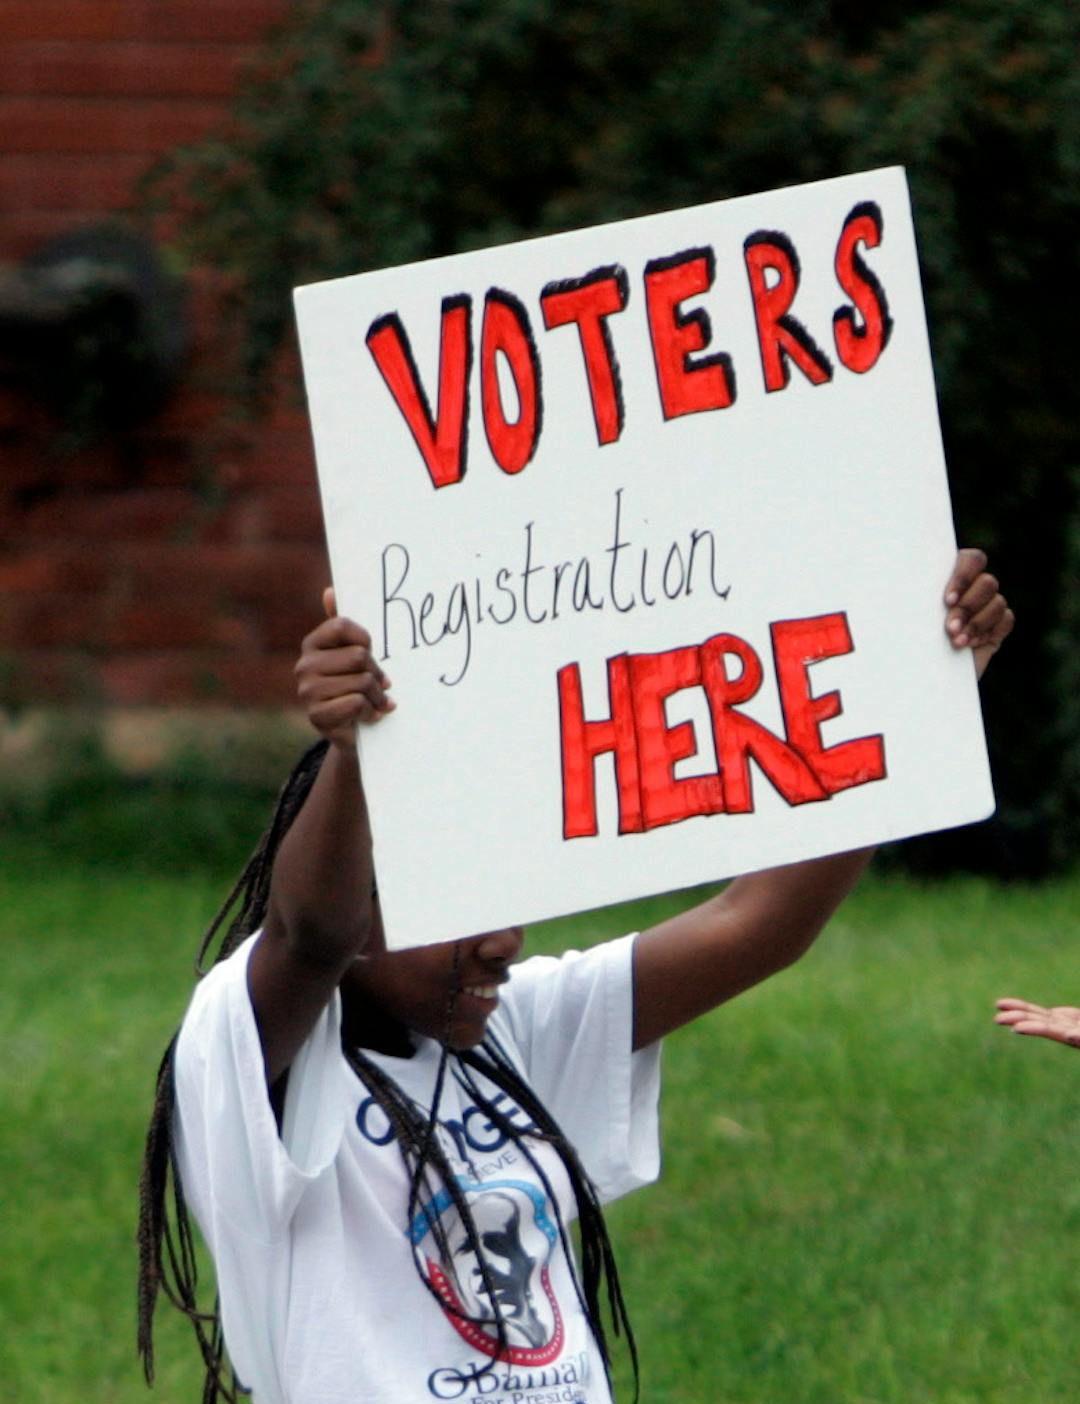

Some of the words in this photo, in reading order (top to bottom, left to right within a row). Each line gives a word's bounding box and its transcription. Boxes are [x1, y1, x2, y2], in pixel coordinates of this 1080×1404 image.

[365, 200, 894, 490] VOTERS
[380, 488, 732, 687] Registration
[556, 611, 888, 841] HERE
[428, 1361, 579, 1399] Obama
